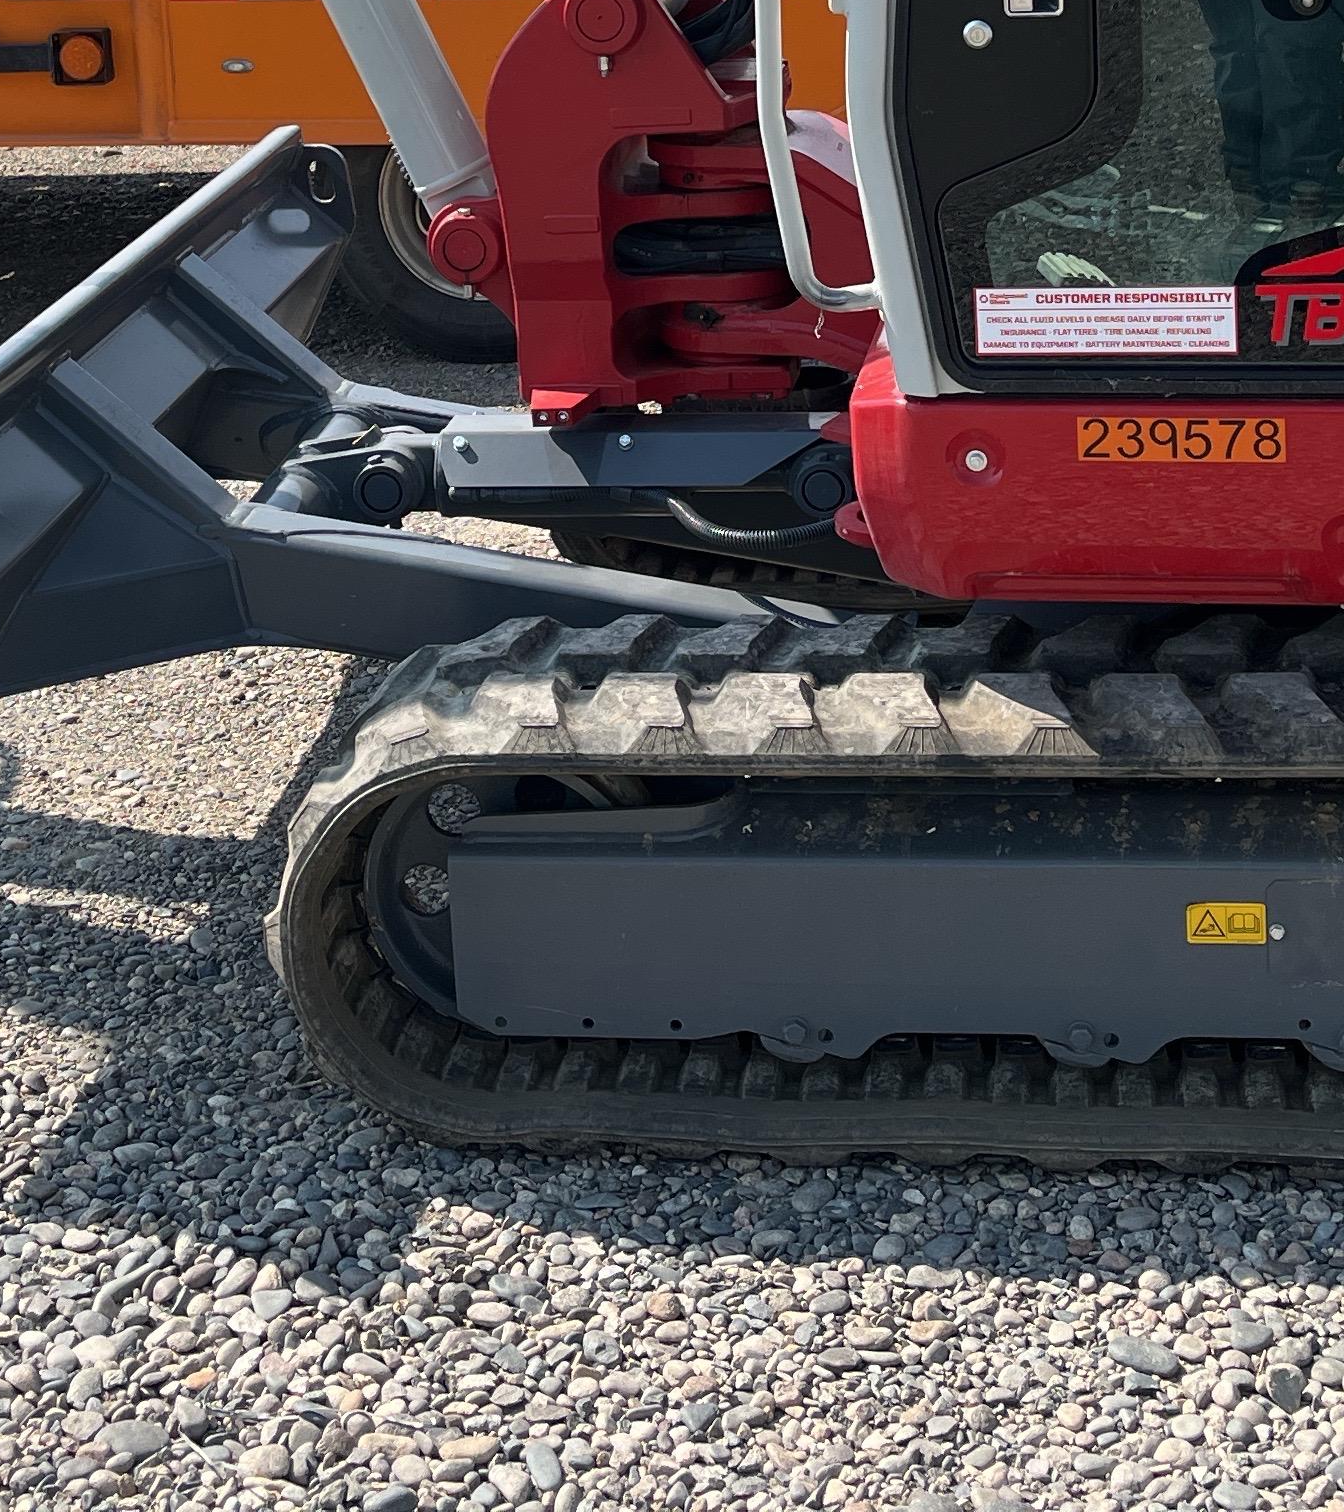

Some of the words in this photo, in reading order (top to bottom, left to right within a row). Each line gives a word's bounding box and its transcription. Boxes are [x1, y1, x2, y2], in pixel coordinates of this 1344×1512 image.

[1035, 293, 1111, 304] CUSTOMER
[1114, 292, 1232, 304] RESPONSIBILITY
[986, 316, 1013, 324] CHECK
[1014, 316, 1029, 324] ALL
[1093, 315, 1126, 323] GREASE
[1127, 315, 1151, 323] DAILY
[1166, 327, 1212, 335] REFUELING
[1031, 341, 1079, 349] EQUIPMENT
[1123, 340, 1183, 348] MAINTENANCE
[1188, 340, 1230, 348] CLEANING
[1082, 418, 1282, 460] 239578
